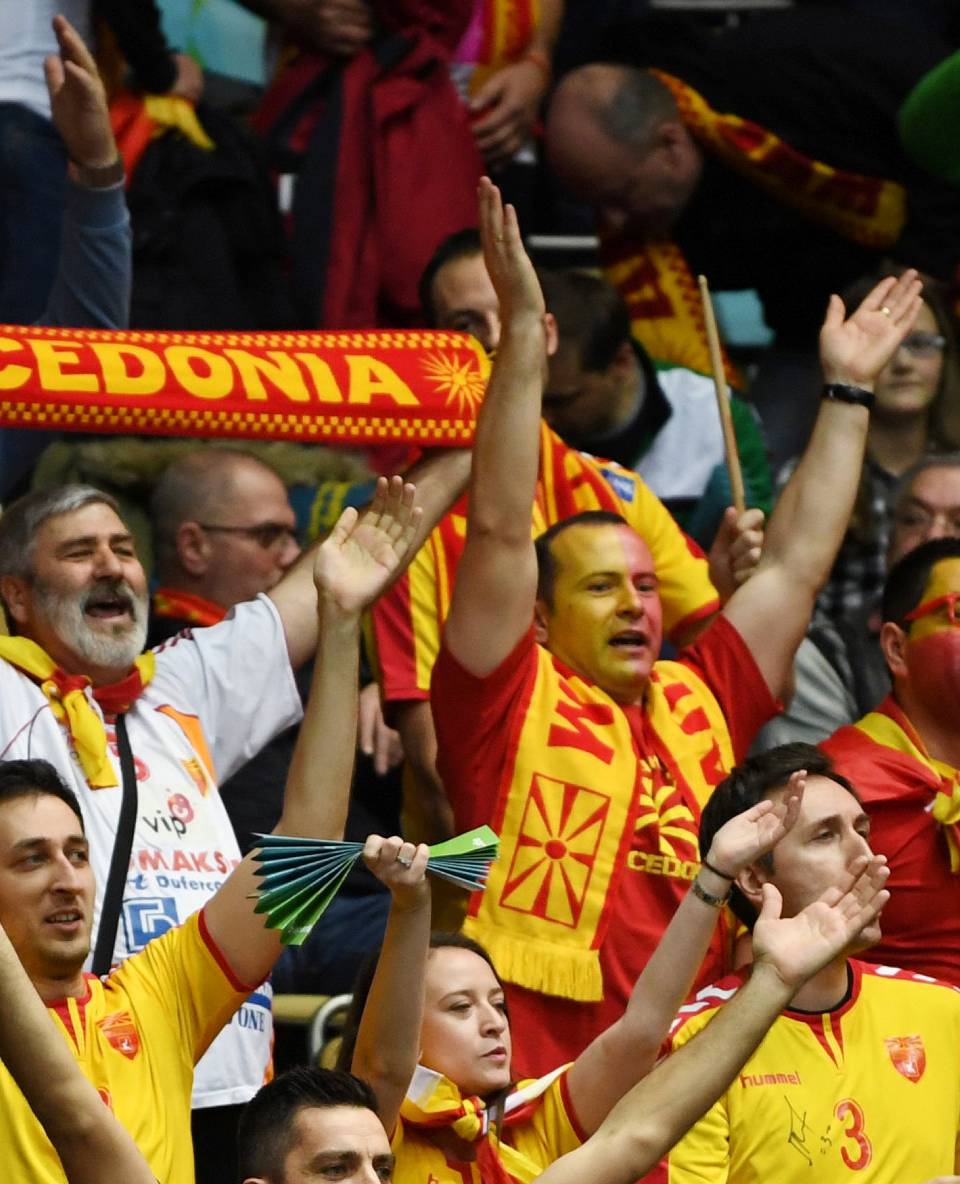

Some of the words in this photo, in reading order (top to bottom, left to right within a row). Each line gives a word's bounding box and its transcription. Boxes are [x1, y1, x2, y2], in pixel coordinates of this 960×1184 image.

[142, 809, 187, 840] vip
[739, 1071, 801, 1089] hummel
[834, 1099, 873, 1171] 3
